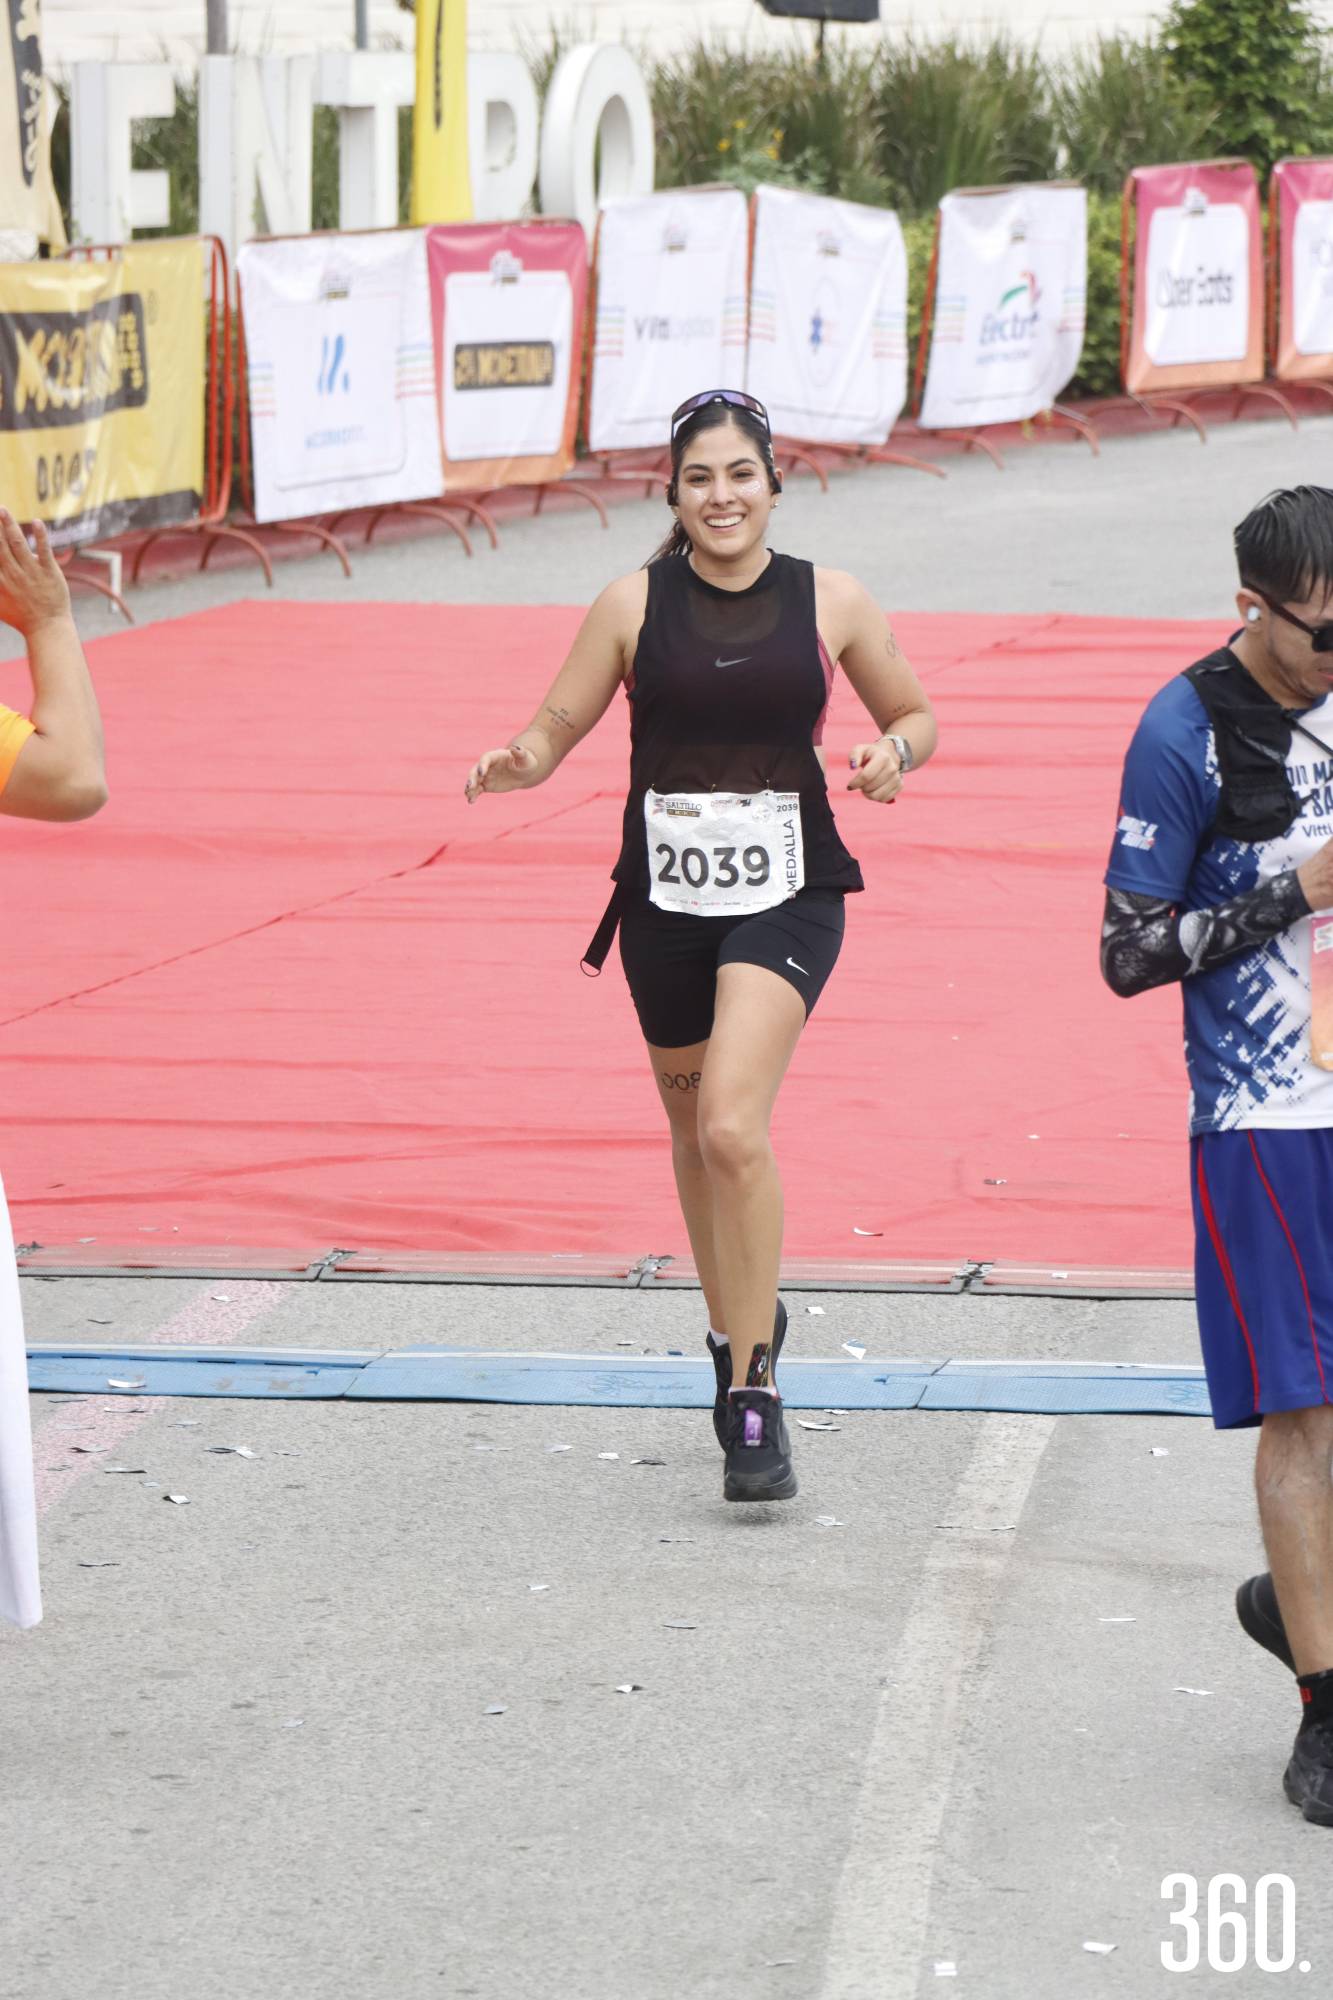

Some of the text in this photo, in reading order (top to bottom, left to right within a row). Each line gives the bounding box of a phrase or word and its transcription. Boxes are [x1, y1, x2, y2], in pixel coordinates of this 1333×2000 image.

[665, 801, 702, 810] SALTILLO
[776, 803, 798, 813] 2039
[656, 843, 770, 888] 2039
[783, 819, 797, 893] MEDALLA
